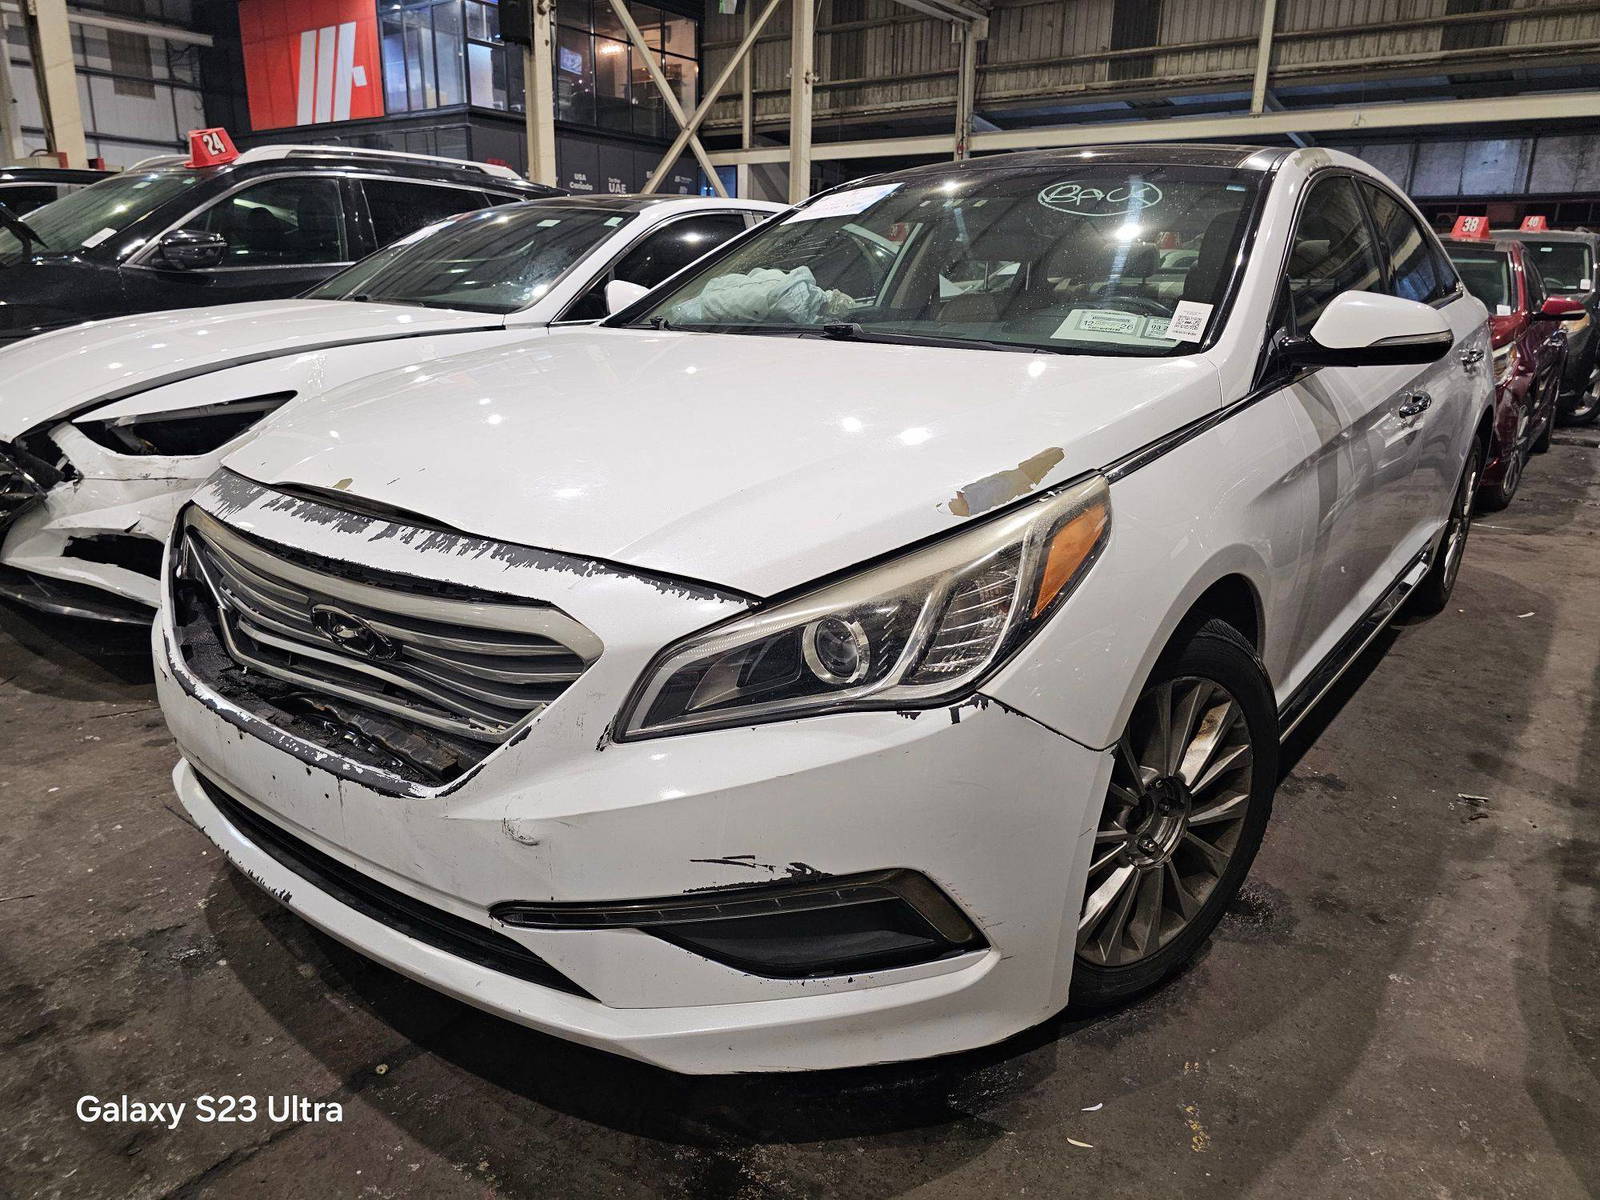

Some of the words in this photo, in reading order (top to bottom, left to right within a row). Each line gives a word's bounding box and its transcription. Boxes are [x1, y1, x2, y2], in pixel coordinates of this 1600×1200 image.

[203, 132, 226, 156] 24
[574, 173, 587, 181] USA
[608, 183, 627, 194] UAE
[1462, 217, 1480, 232] 38
